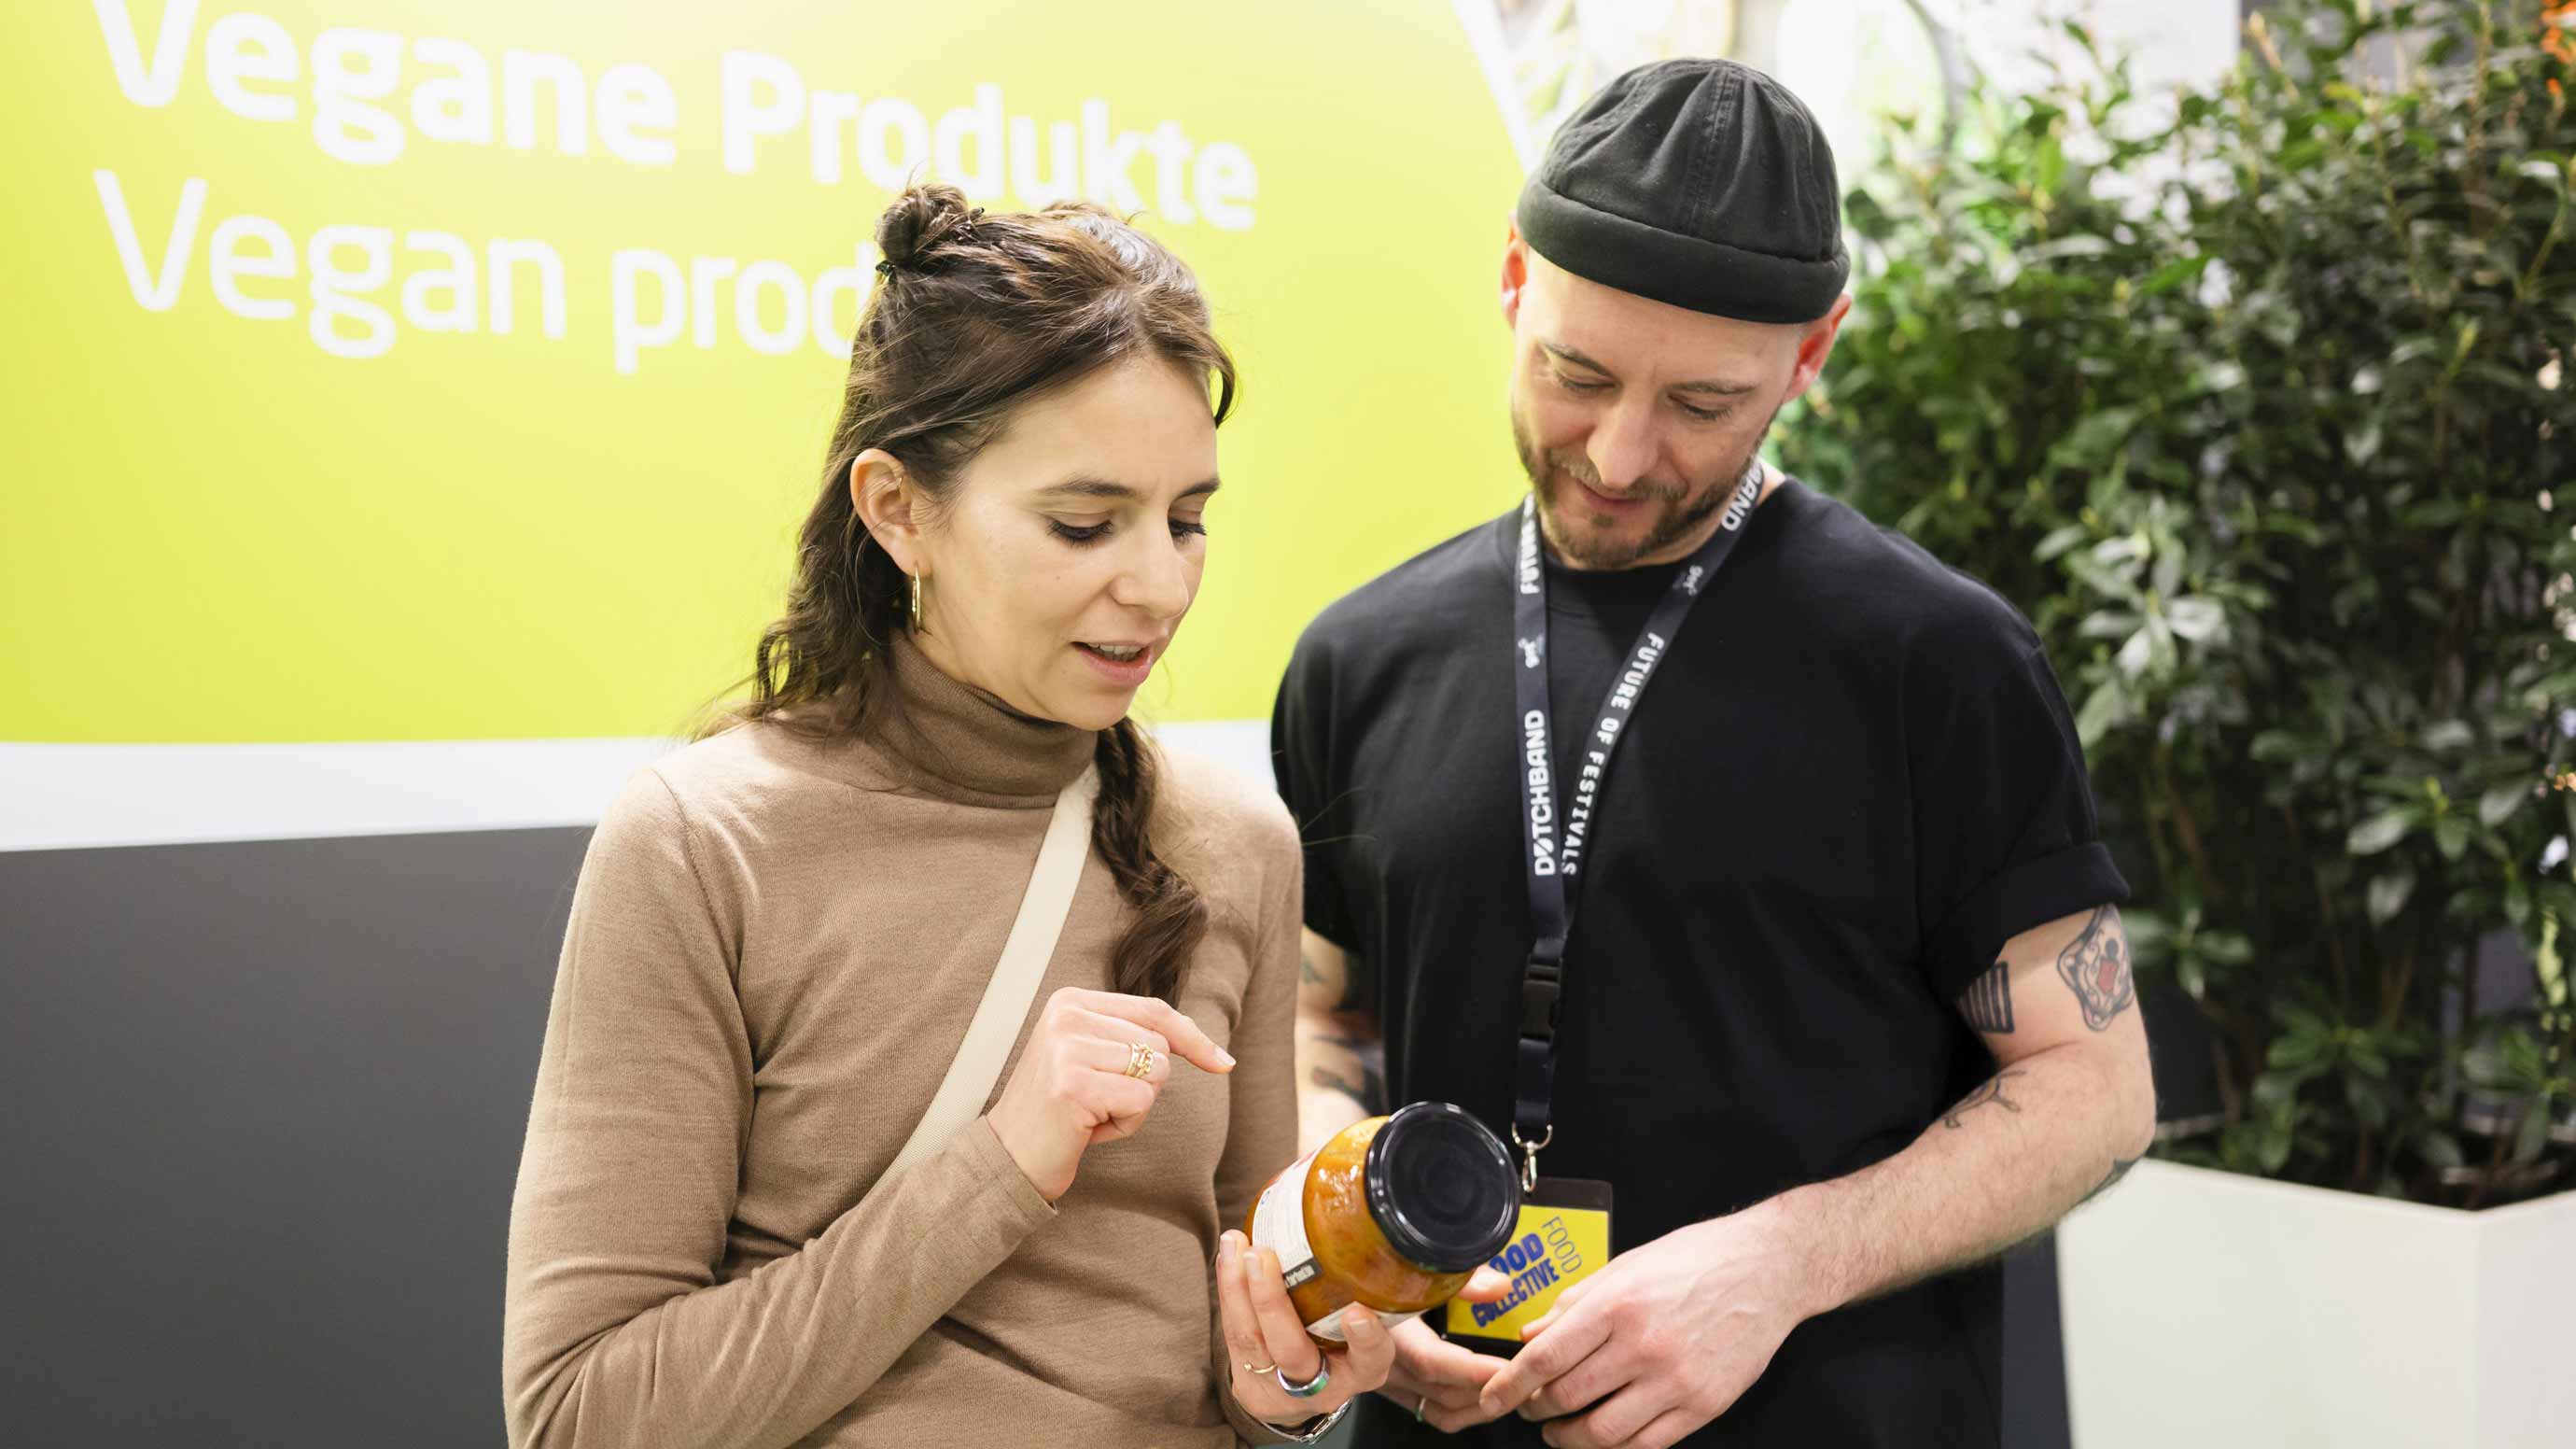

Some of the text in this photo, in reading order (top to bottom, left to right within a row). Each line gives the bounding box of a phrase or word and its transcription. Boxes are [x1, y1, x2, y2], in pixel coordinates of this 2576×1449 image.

[91, 0, 1258, 232] Vegane Produkte
[92, 168, 875, 375] Vegan prod
[1561, 632, 1665, 876] FUTURE OF FESTIVALS
[1490, 1232, 1545, 1275] OOD
[1542, 1216, 1583, 1273] FOOD
